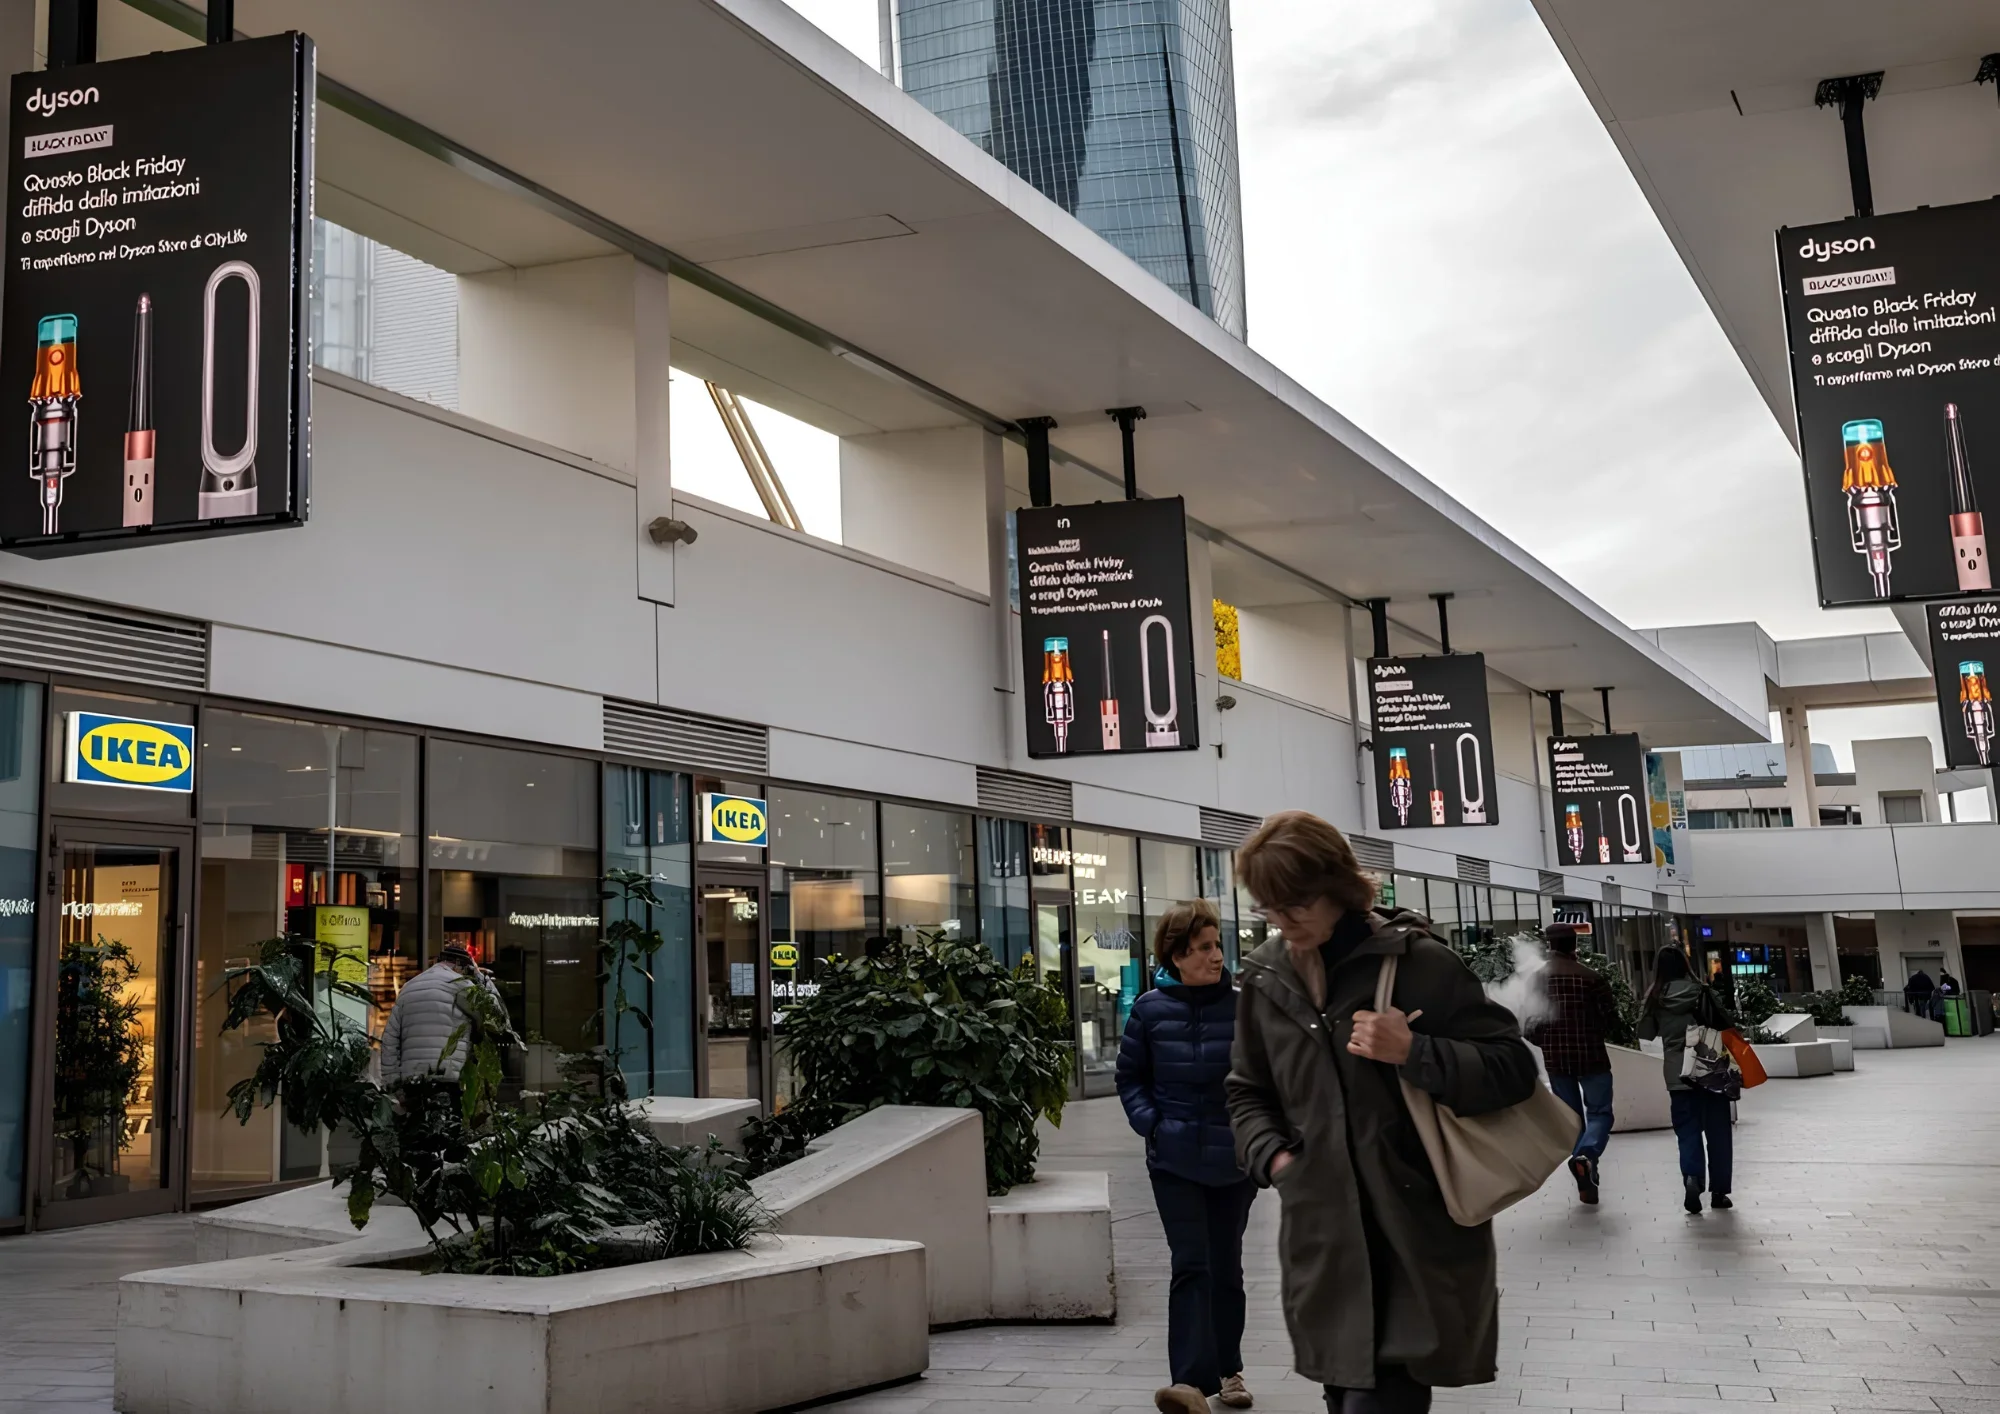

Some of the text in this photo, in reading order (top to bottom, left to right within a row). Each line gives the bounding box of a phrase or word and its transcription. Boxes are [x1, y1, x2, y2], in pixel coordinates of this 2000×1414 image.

[26, 87, 99, 117] dyson
[88, 160, 130, 183] Black
[136, 155, 186, 177] Friday
[22, 194, 73, 218] diffida
[122, 177, 200, 205] imitazioni
[86, 217, 136, 238] Dyson
[1799, 236, 1875, 262] dyson
[1874, 295, 1919, 315] Black
[1924, 289, 1976, 308] Friday
[1809, 324, 1862, 344] diffida
[1913, 307, 1996, 331] imitazioni
[1878, 342, 1931, 359] Dyson
[91, 734, 183, 769] IKEA
[717, 808, 761, 831] IKEA
